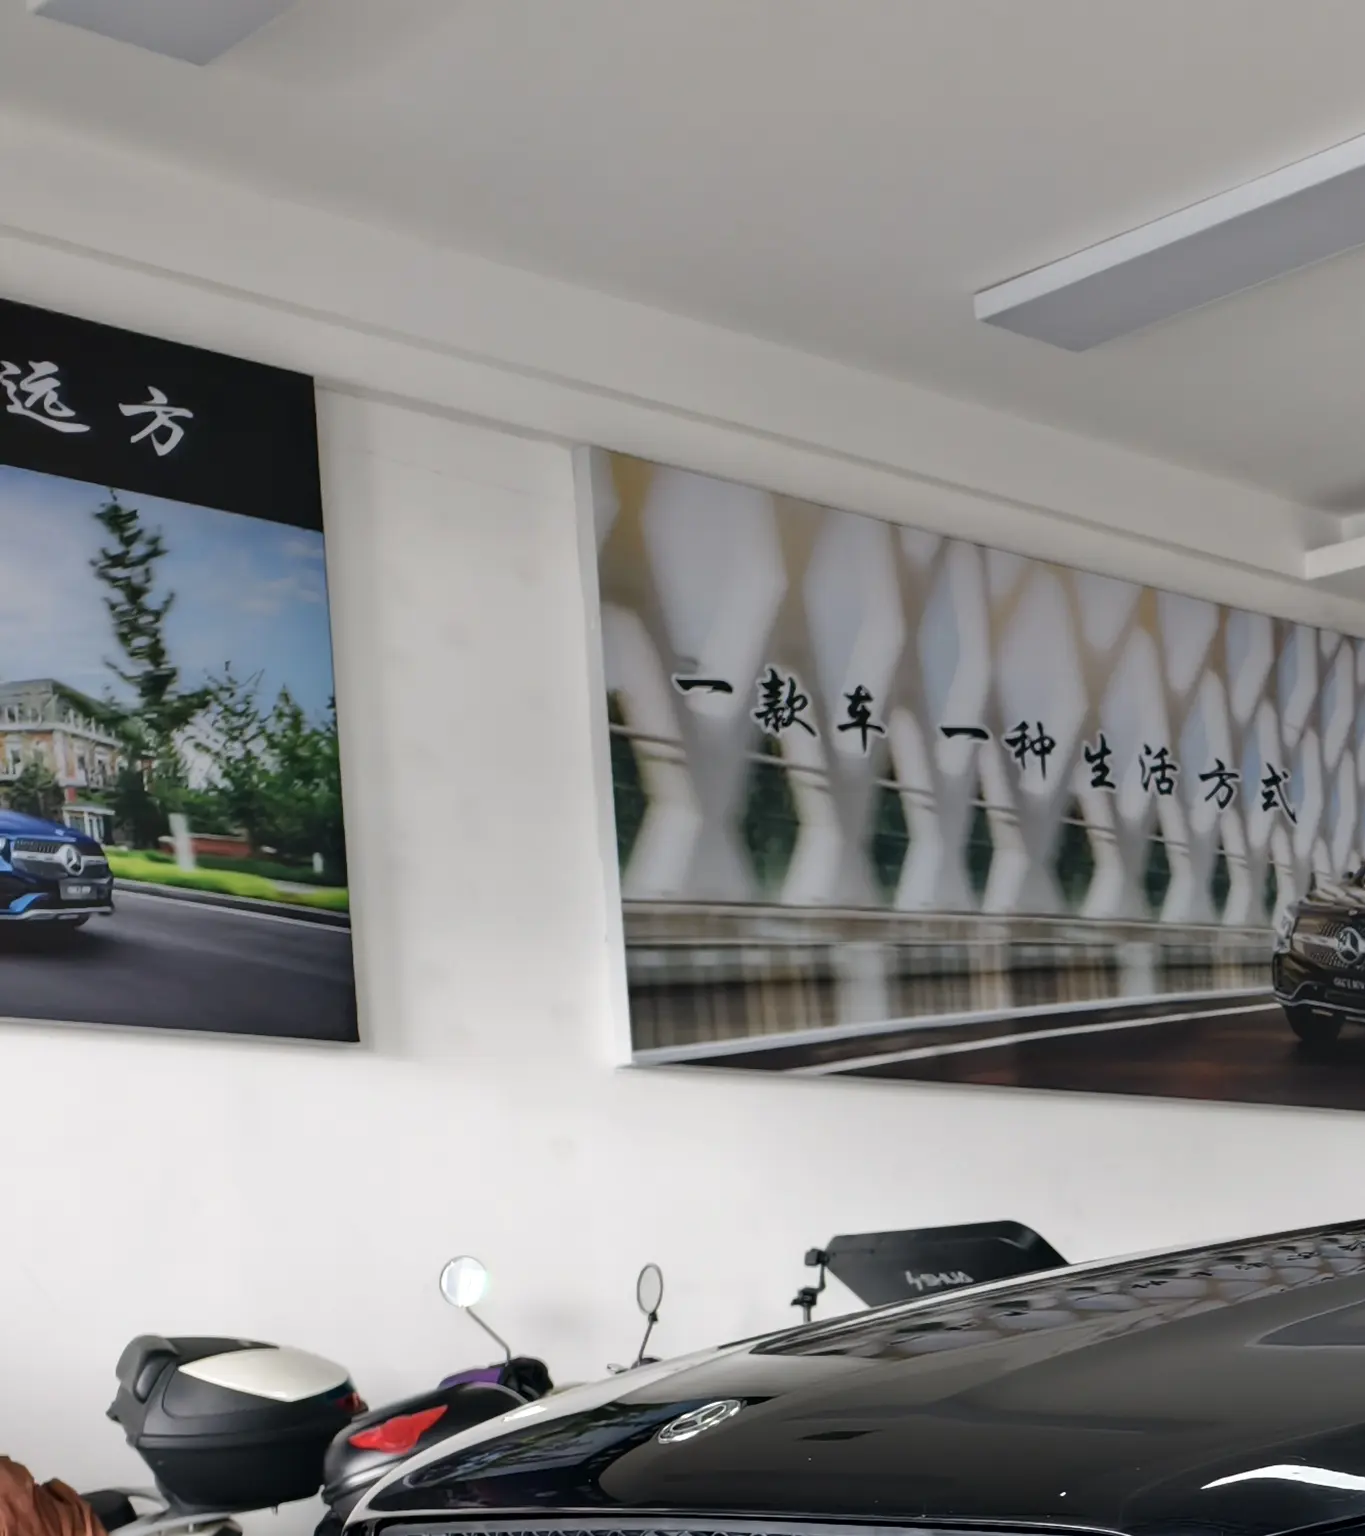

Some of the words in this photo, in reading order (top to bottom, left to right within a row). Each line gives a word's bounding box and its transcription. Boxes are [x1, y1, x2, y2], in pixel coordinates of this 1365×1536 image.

[0, 360, 194, 457] 远方
[675, 667, 887, 753] 一款车
[940, 719, 1299, 824] 一种生活方式
